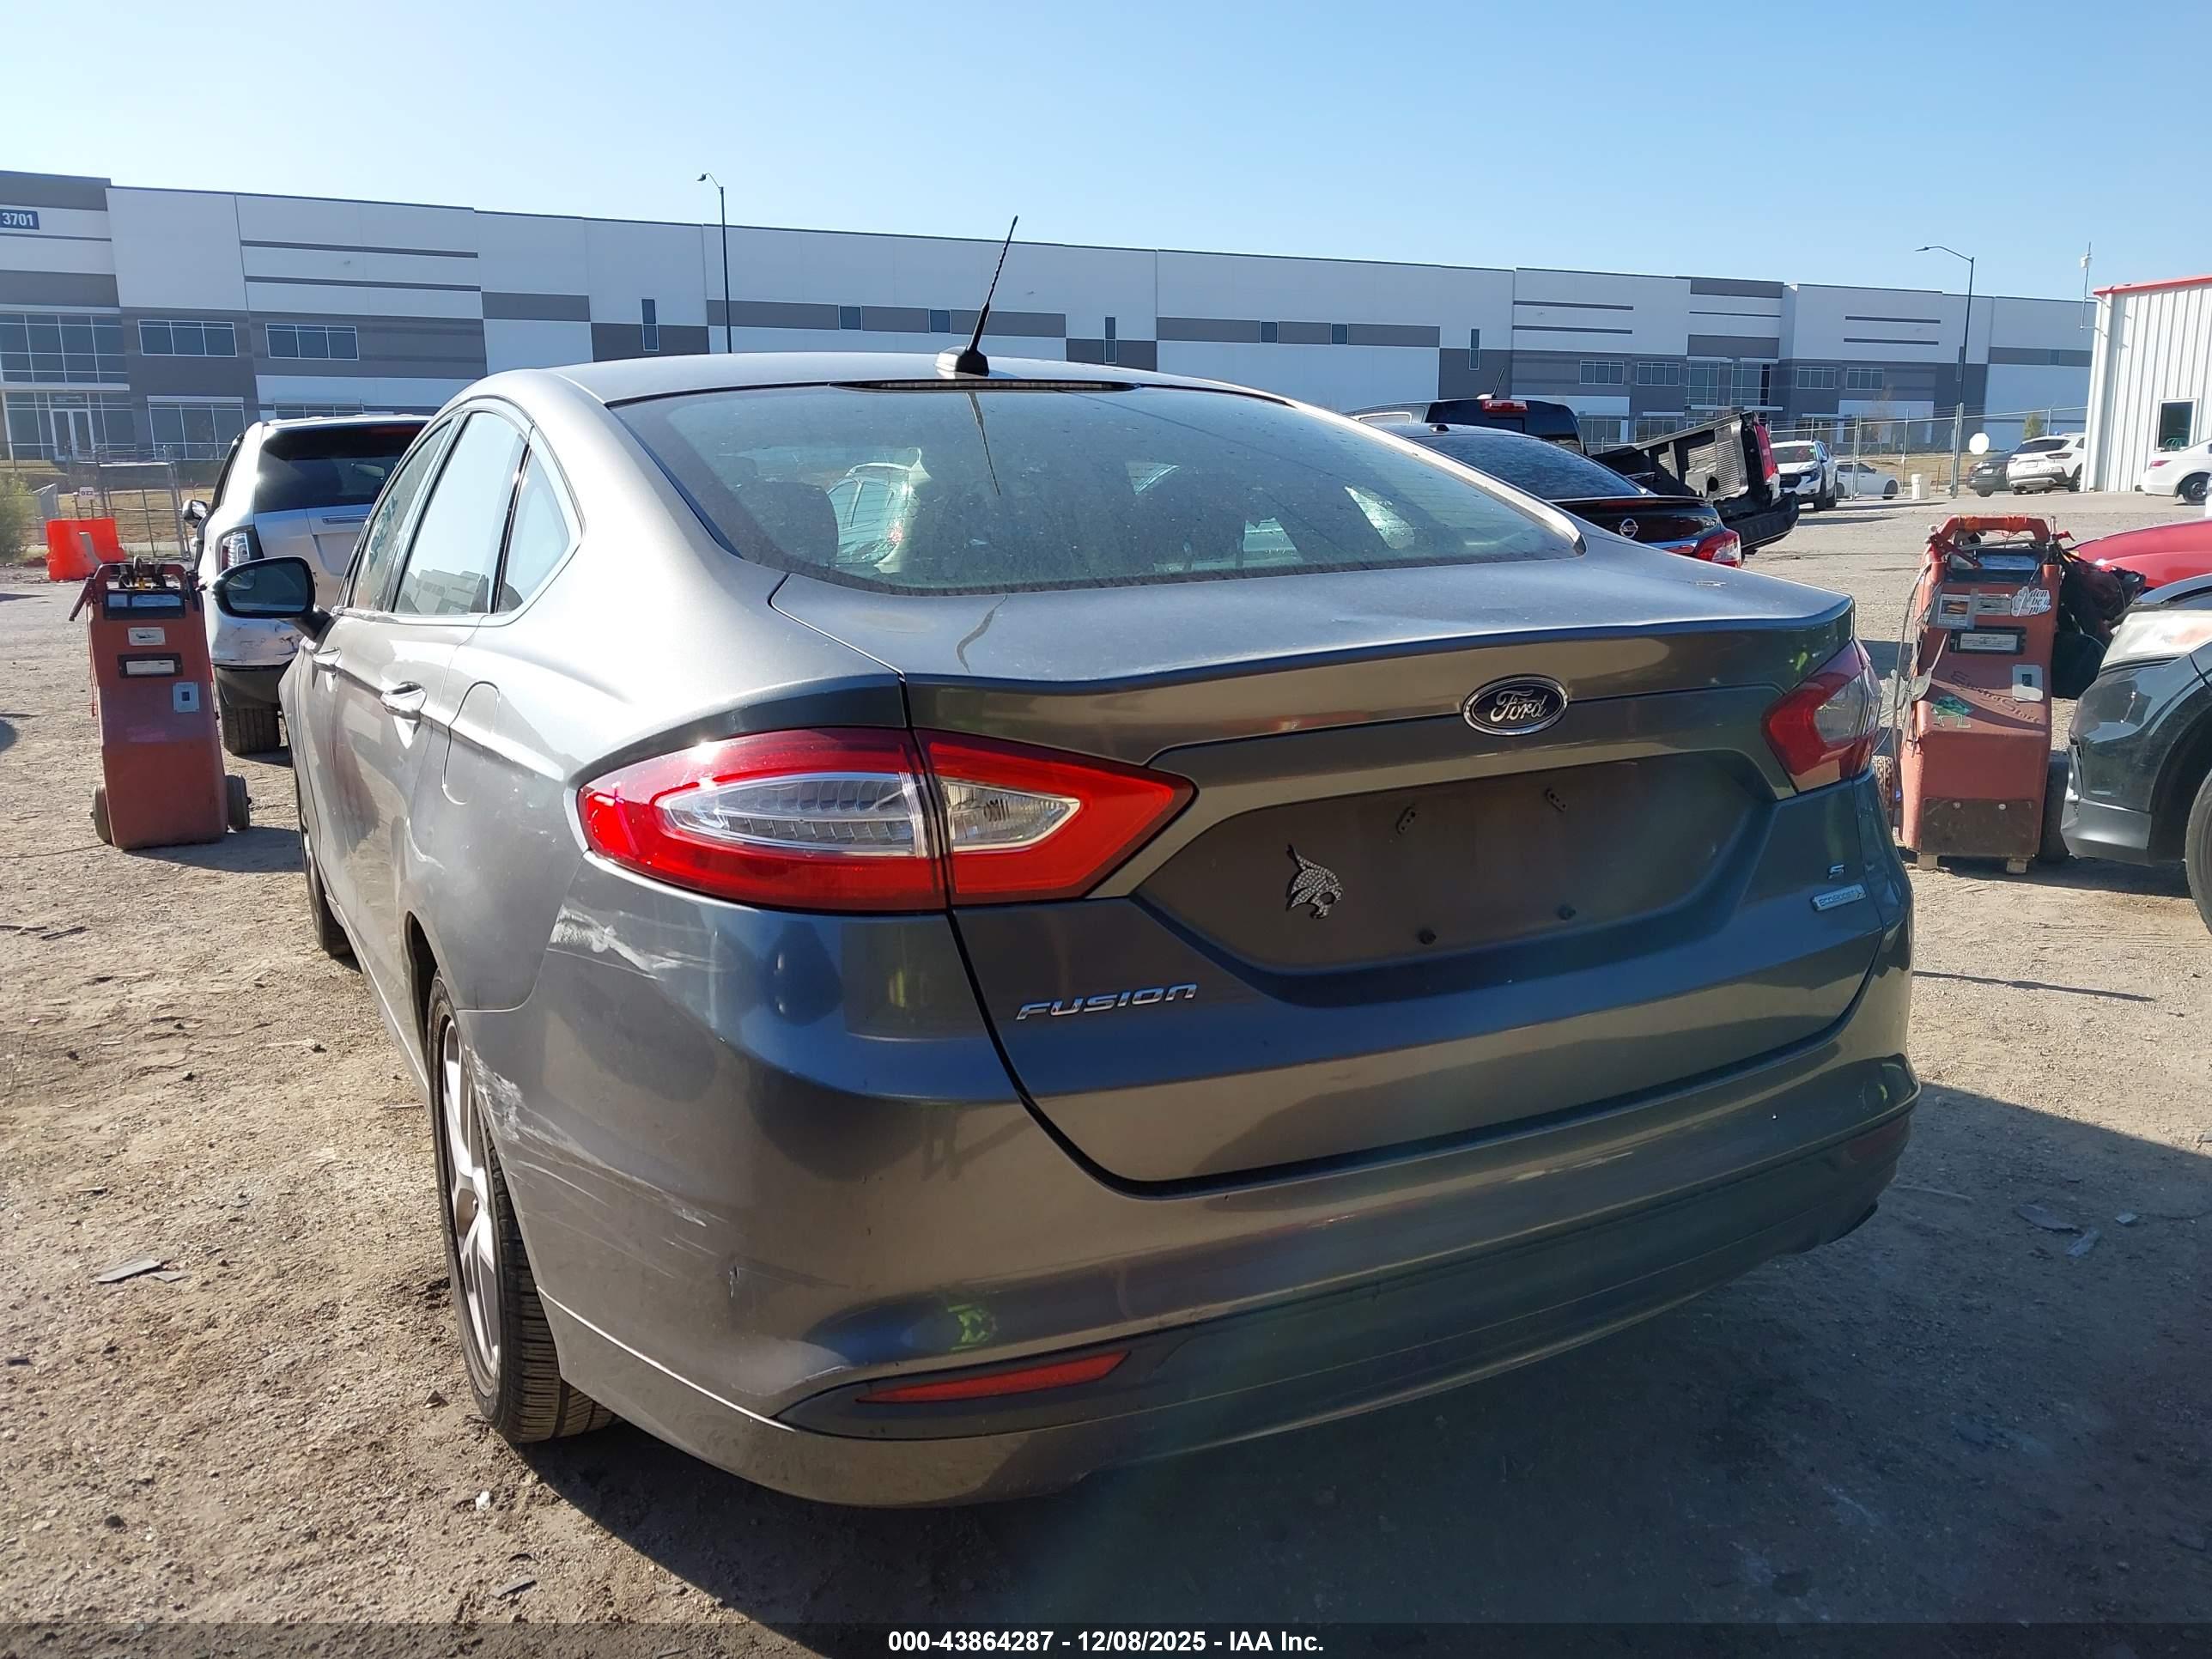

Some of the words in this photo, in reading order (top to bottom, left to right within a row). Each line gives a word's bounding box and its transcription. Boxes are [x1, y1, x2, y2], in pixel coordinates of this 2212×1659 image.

[2, 212, 33, 227] 3701
[1490, 689, 1547, 722] Ford
[1016, 983, 1198, 1021] FUSION
